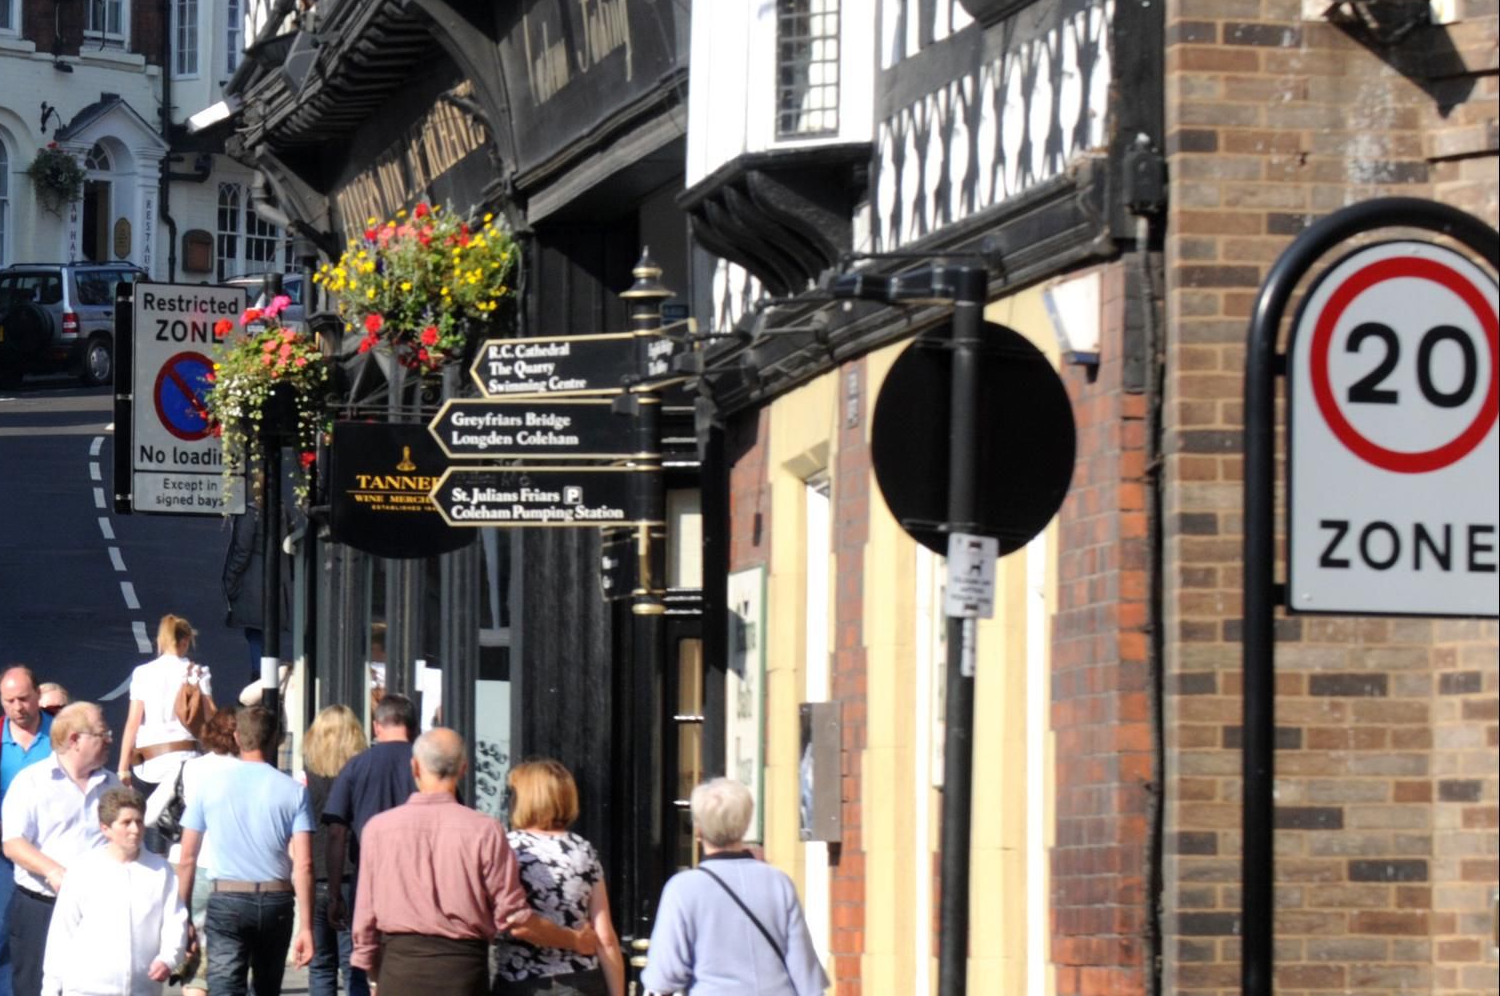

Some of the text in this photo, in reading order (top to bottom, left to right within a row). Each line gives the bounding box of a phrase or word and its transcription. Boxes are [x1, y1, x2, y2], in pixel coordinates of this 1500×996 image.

[143, 292, 239, 315] Restricted
[488, 342, 570, 359] R.C. Cathedral
[488, 360, 556, 379] The Quarry
[1345, 322, 1478, 408] 20
[488, 376, 588, 394] Swimming Centre
[451, 412, 571, 430] Greyfriars Bridge
[451, 431, 580, 449] Longden Coleham
[140, 445, 166, 464] No
[163, 478, 218, 491] Except in
[156, 494, 225, 509] signed bays
[355, 494, 434, 504] WINE MERCH
[451, 488, 579, 505] St. Julians Friars P
[451, 505, 625, 522] Coleham Pumping Station
[1319, 520, 1498, 573] ZONE
